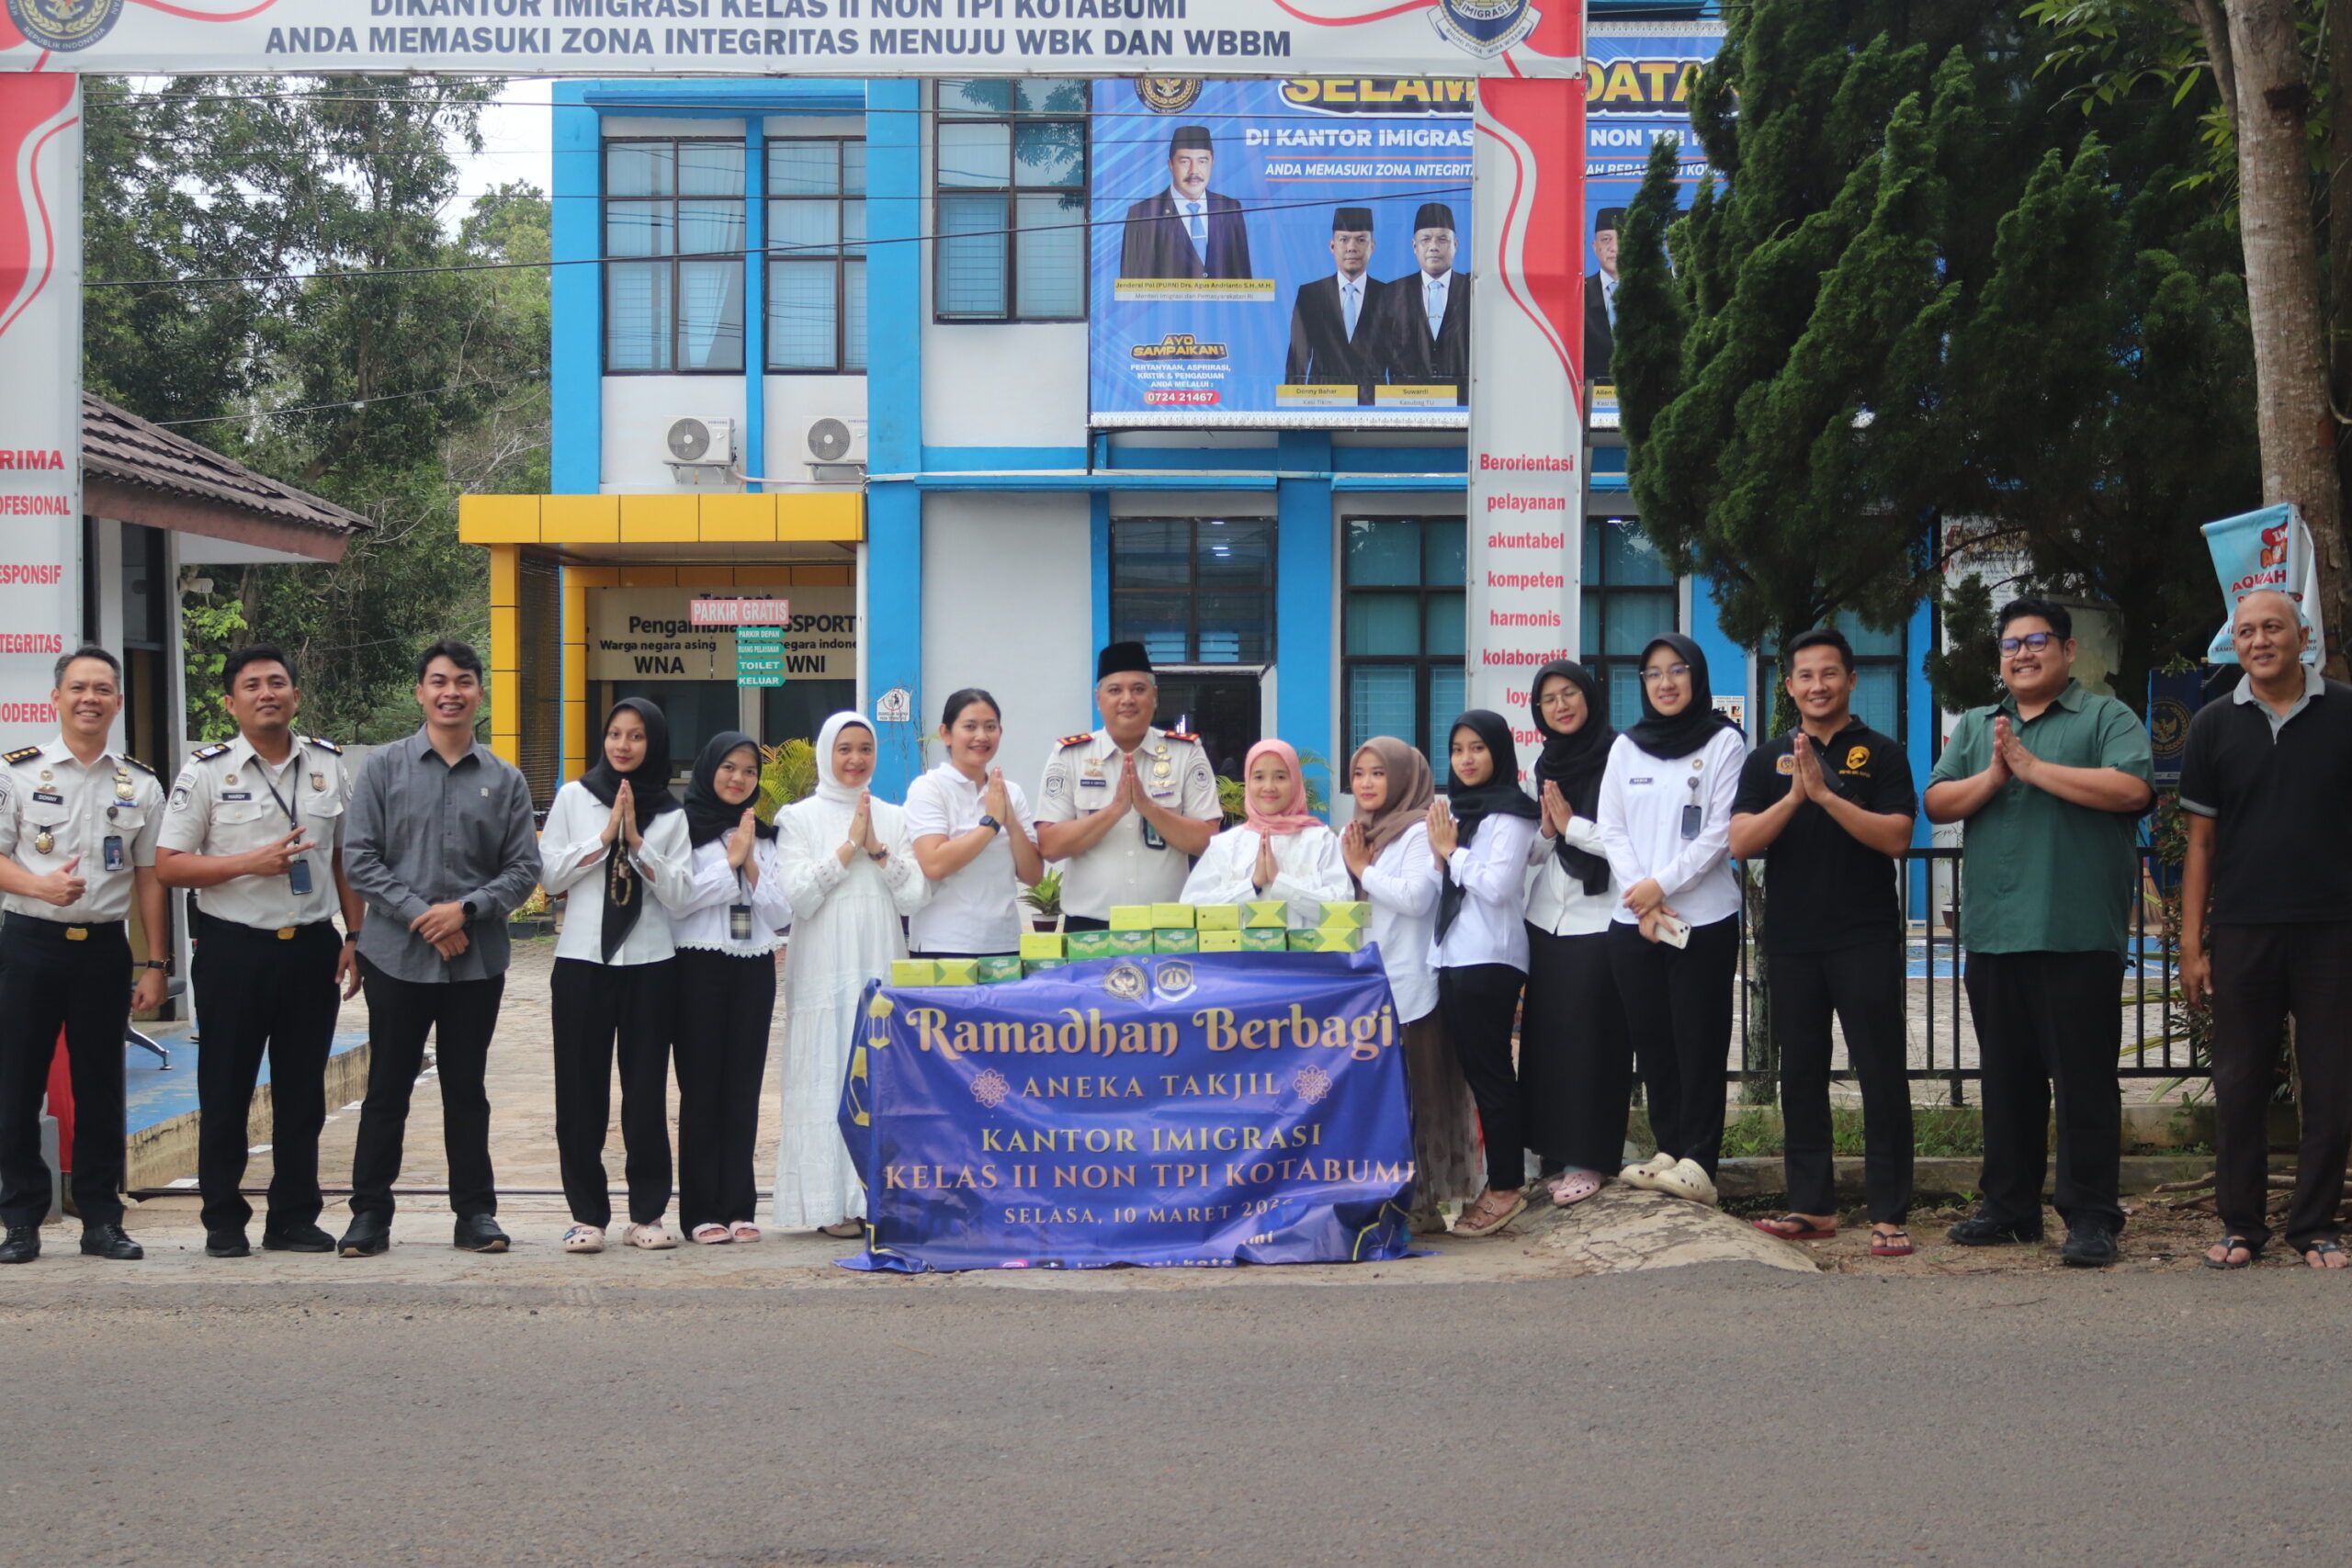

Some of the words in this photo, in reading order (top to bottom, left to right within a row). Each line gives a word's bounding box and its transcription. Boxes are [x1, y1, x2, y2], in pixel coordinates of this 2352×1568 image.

[371, 0, 541, 17] DIKANTOR
[553, 0, 709, 18] IMIGRASI
[721, 0, 829, 18] KELAS
[839, 0, 859, 18] II
[871, 0, 943, 18] NON
[955, 0, 1003, 19] TPI
[1014, 0, 1187, 19] KOTABUMI
[1461, 3, 1509, 18] IMIGRASI
[23, 26, 62, 50] REPUBLIK
[62, 27, 107, 50] INDONESIA
[265, 27, 358, 54] ANDA
[368, 27, 551, 54] MEMASUKI
[560, 28, 654, 54] ZONA
[664, 28, 860, 55] INTEGRITAS
[869, 28, 1005, 55] MENUJU
[1015, 28, 1094, 56] WBK
[1103, 28, 1173, 56] DAN
[1183, 30, 1292, 57] WBBM
[1245, 129, 1268, 147] DI
[1276, 129, 1372, 147] KANTOR
[1379, 129, 1474, 147] IMIGRAS
[1590, 129, 1643, 147] NON
[1264, 164, 1302, 176] ANDA
[1305, 164, 1373, 176] MEMASUKI
[1376, 164, 1412, 176] ZONA
[1162, 335, 1194, 346] AYO
[1148, 392, 1176, 401] 0724
[1178, 392, 1214, 401] 21467
[0, 449, 65, 470] RIMA
[1480, 453, 1574, 471] Berorientasi
[1487, 493, 1566, 513] pelayanan
[1487, 531, 1565, 549] akuntabel
[1487, 570, 1565, 592] kompeten
[694, 602, 739, 622] PARKIR
[741, 602, 788, 622] GRATIS
[1490, 609, 1562, 626] harmonis
[738, 630, 760, 638] PARKIR
[760, 630, 780, 638] DEPAN
[0, 634, 62, 654] TEGRITAS
[599, 640, 638, 652] Warga
[640, 642, 682, 653] negara
[684, 639, 717, 652] asing
[634, 656, 685, 674] WNA
[740, 661, 780, 670] TOILET
[786, 655, 825, 673] WNI
[738, 676, 780, 685] KELUAR
[1, 703, 57, 723] ODEREN
[905, 1007, 1180, 1060] Ramadhan
[1192, 1004, 1395, 1061] Berbagi
[1022, 1073, 1145, 1100] ANEKA
[1159, 1072, 1283, 1101] TAKJIL
[981, 1127, 1138, 1154] KANTOR
[1151, 1123, 1323, 1152] IMIGRASI
[885, 1164, 999, 1191] KELAS
[1012, 1164, 1038, 1189] II
[1054, 1164, 1138, 1189] NON
[1150, 1163, 1210, 1188] TPI
[1226, 1158, 1417, 1187] KOTABUMI
[1004, 1208, 1103, 1225] SELASA,
[1114, 1208, 1137, 1224] 10
[1148, 1204, 1232, 1224] MARET
[1241, 1198, 1294, 1217] 202
